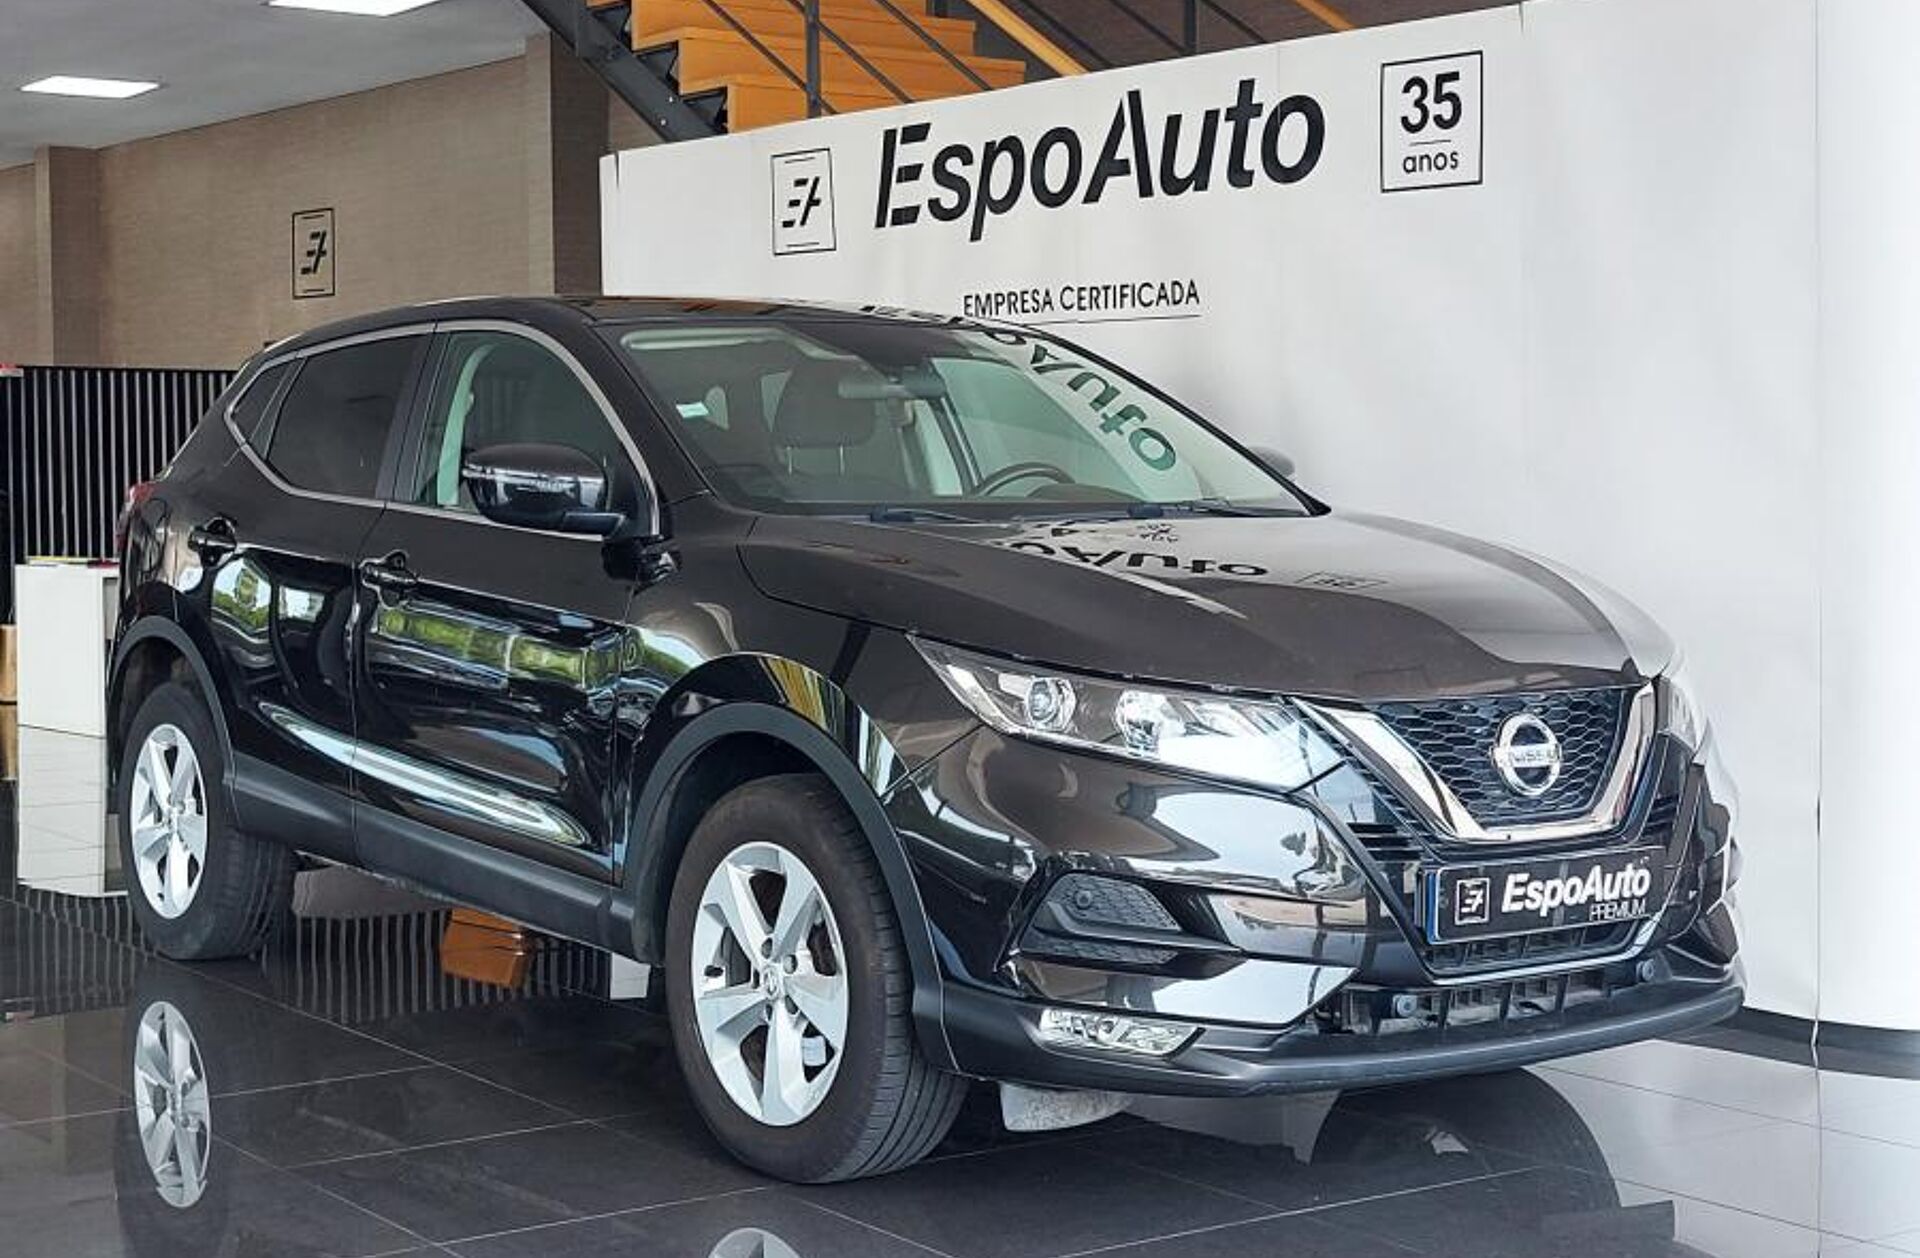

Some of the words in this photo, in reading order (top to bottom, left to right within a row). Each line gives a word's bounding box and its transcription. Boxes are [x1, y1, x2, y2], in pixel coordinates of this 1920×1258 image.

[1401, 71, 1462, 133] 35
[875, 79, 1326, 242] EspoAuto
[1403, 151, 1458, 174] anos
[963, 290, 1054, 318] EMPRESA
[1059, 279, 1200, 311] CERTIFICADA
[1501, 863, 1651, 917] EspoAuto
[1589, 899, 1646, 922] PREMIUM
